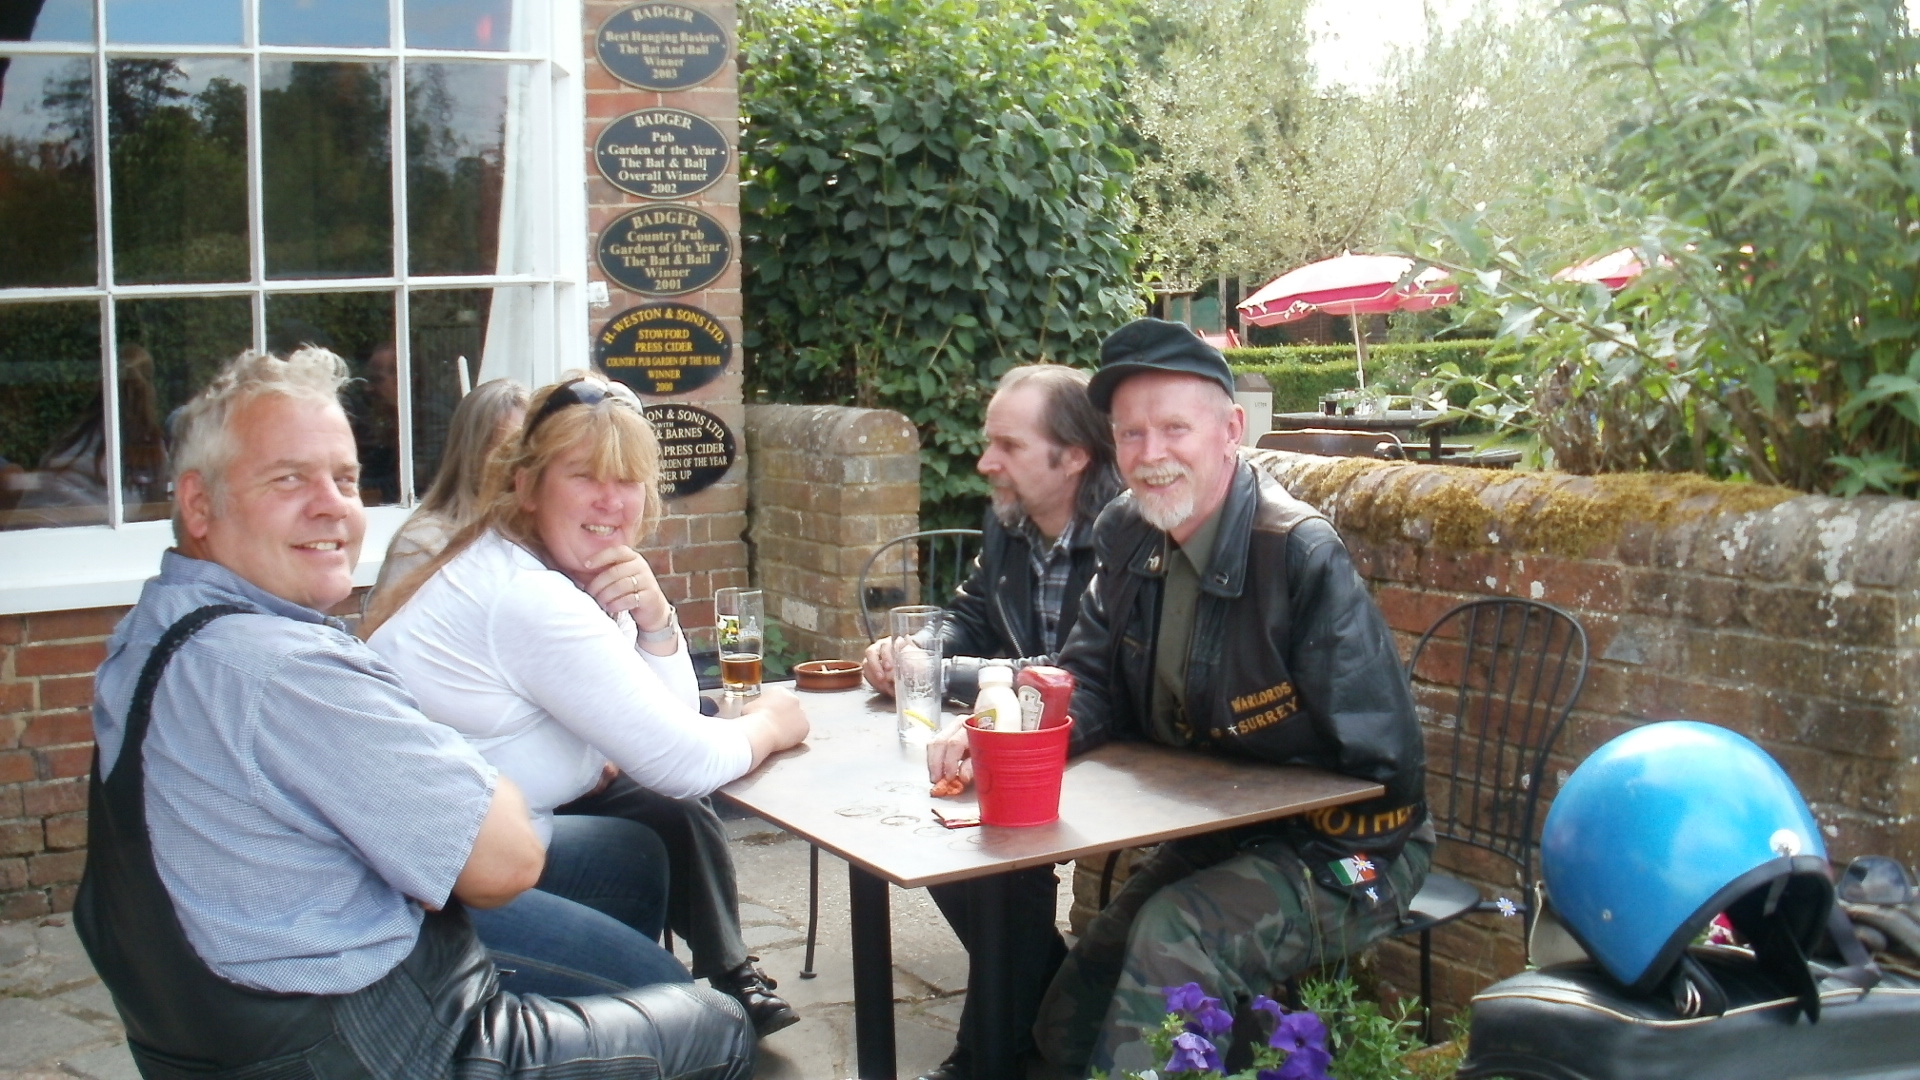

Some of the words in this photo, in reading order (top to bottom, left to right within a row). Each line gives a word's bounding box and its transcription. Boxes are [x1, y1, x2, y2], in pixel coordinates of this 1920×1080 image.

[632, 5, 694, 23] BADGER
[631, 31, 679, 44] Hanging
[619, 43, 639, 55] The
[641, 43, 660, 55] Bat
[663, 44, 685, 55] And
[643, 55, 684, 67] Winner
[634, 113, 692, 130] BADGER
[651, 131, 675, 142] Pub
[608, 144, 651, 156] Garden
[654, 144, 667, 156] of
[670, 145, 687, 156] the
[691, 144, 718, 156] Year
[619, 157, 642, 169] The
[645, 157, 665, 169] Bat
[668, 157, 679, 169] &
[684, 157, 707, 169] Ball
[618, 169, 661, 181] Overall
[664, 169, 708, 181] Winner
[651, 182, 677, 194] 2002
[631, 210, 699, 229] BADGER
[627, 230, 677, 243] Country
[681, 229, 705, 241] Pub
[609, 243, 656, 255] Garden
[658, 242, 672, 254] of
[673, 242, 691, 253] the
[695, 241, 722, 253] Year
[622, 255, 647, 267] The
[649, 254, 670, 266] Bat
[673, 254, 683, 266] &
[686, 253, 711, 265] Ball
[644, 266, 691, 278] Winner
[654, 279, 681, 291] 2001
[612, 308, 662, 334] WESTON
[664, 307, 674, 320] &
[676, 308, 706, 327] SONS
[638, 328, 690, 340] STOWFORD
[635, 341, 663, 353] PRESS
[664, 341, 693, 352] CIDER
[606, 356, 637, 367] COUNTRY
[638, 356, 651, 367] PUB
[651, 356, 679, 367] GARDEN
[680, 355, 689, 366] OF
[689, 355, 703, 366] THE
[704, 355, 721, 366] YEAR
[647, 369, 681, 380] WINNER
[666, 408, 675, 420] &
[677, 409, 706, 426] SONS
[655, 429, 663, 440] &
[665, 427, 703, 439] BARNES
[664, 444, 693, 456] PRESS
[695, 443, 725, 454] CIDER
[658, 459, 682, 469] ARDEN
[683, 458, 692, 468] OF
[694, 457, 708, 467] THE
[709, 456, 728, 466] YEAR
[680, 470, 692, 480] UP
[660, 483, 676, 494] 1999
[1231, 682, 1292, 713] WARLORDS
[1238, 696, 1297, 734] SURREY
